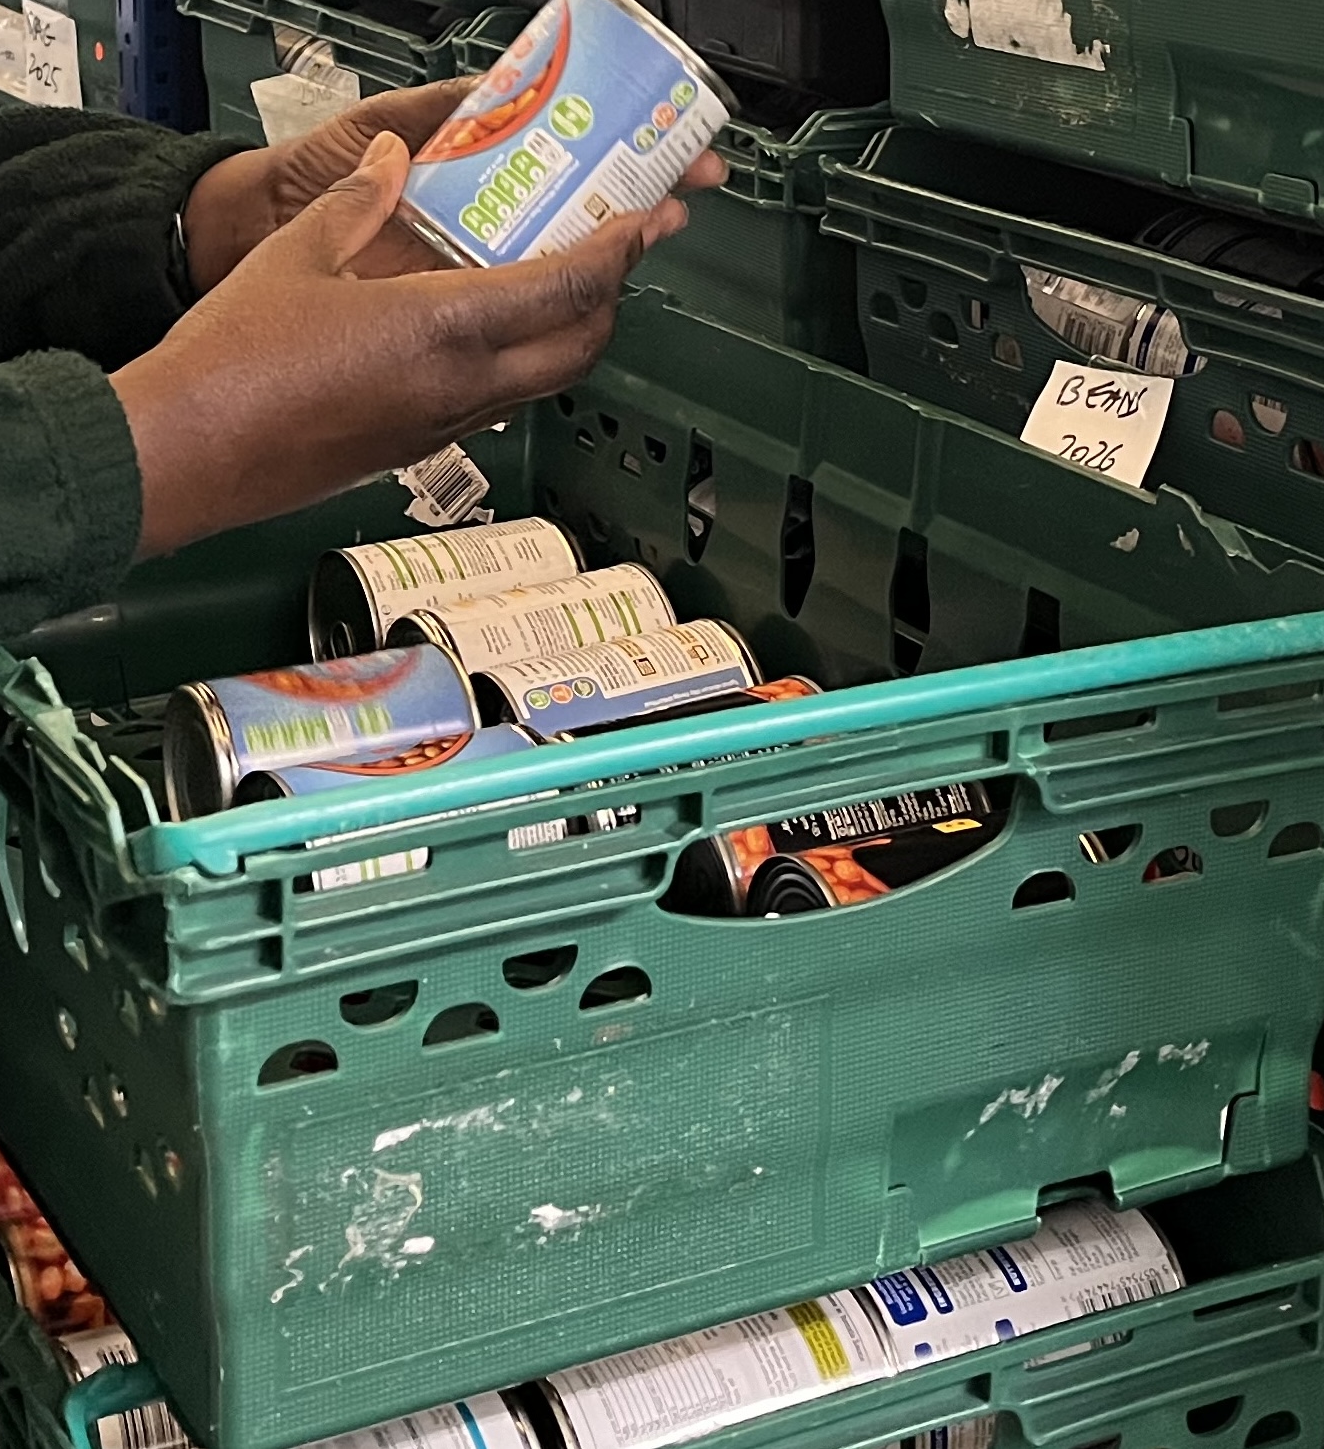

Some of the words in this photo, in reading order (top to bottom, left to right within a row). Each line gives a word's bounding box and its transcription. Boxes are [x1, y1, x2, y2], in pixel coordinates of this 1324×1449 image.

[28, 52, 63, 94] 2025
[1056, 374, 1148, 419] BEANS
[1056, 434, 1124, 472] 2026
